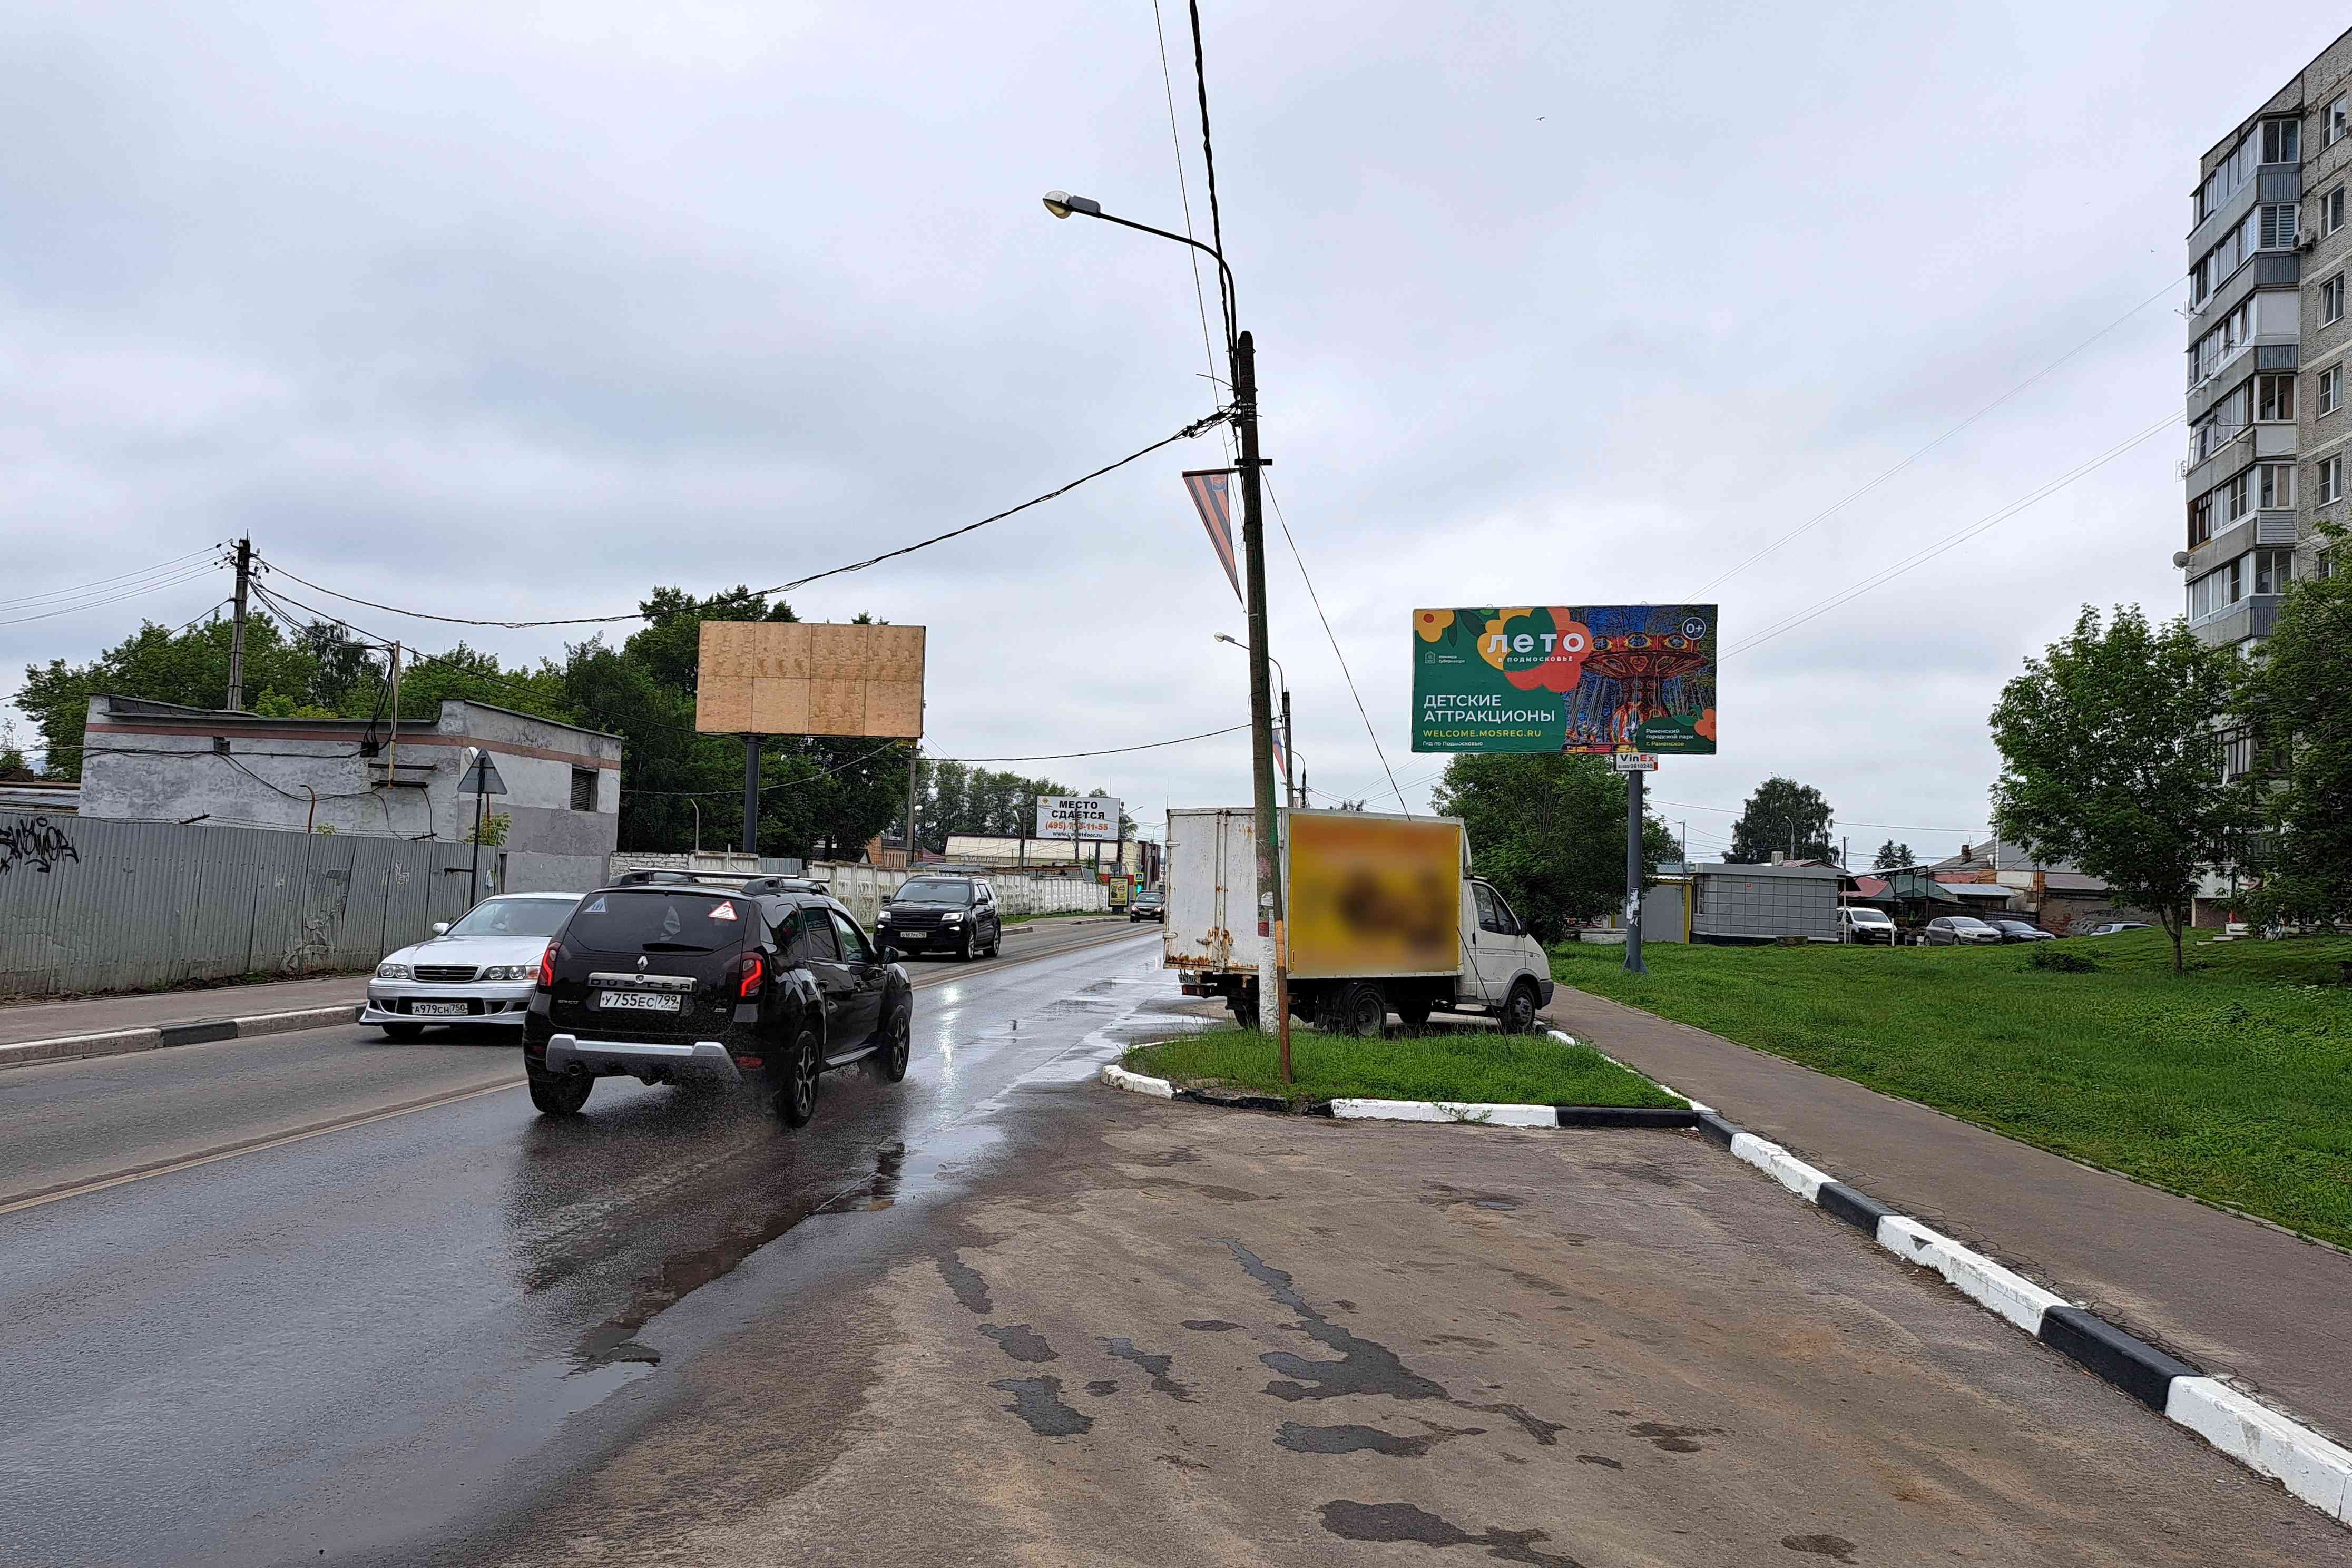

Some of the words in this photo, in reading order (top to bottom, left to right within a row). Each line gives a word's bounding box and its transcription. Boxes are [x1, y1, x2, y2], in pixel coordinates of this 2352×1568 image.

[1687, 623, 1702, 633] 0+
[1423, 694, 1501, 709] ДЕТСКИЕ
[1423, 710, 1555, 724] АТТРАКЦИОНЫ
[1059, 800, 1098, 809] МЕСТО
[1051, 810, 1105, 820] СДАЕТСЯ
[1045, 821, 1066, 831] (495)
[590, 978, 691, 990] DUSTER
